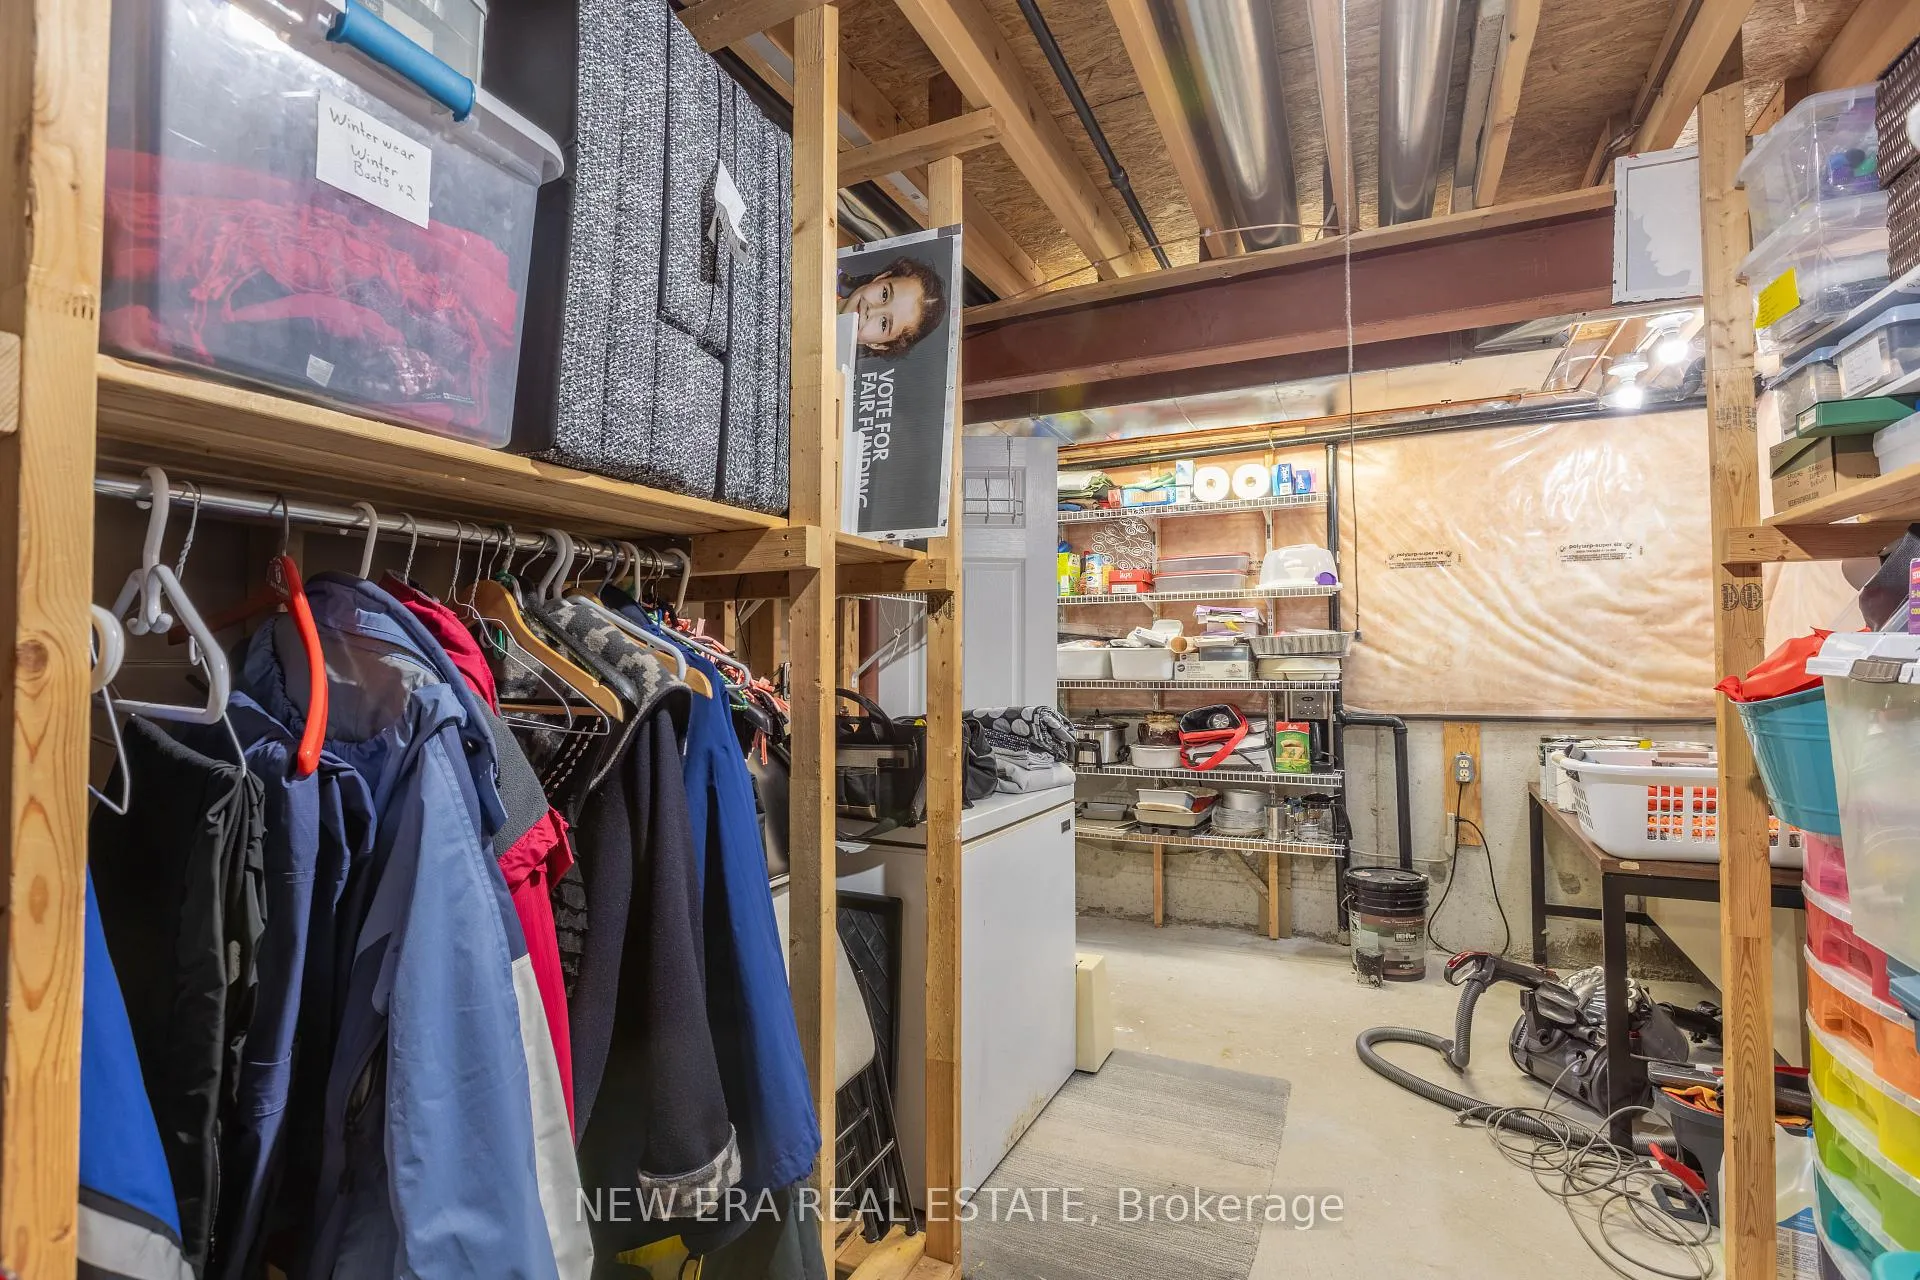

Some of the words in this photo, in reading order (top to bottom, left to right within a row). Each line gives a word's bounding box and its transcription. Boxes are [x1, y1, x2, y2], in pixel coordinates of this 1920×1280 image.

[329, 107, 379, 144] Winter
[382, 140, 416, 161] wear
[351, 144, 398, 176] Winter
[353, 160, 389, 188] Boots
[859, 372, 877, 413] FAIR
[876, 368, 895, 418] VOTE
[872, 422, 891, 462] FOR
